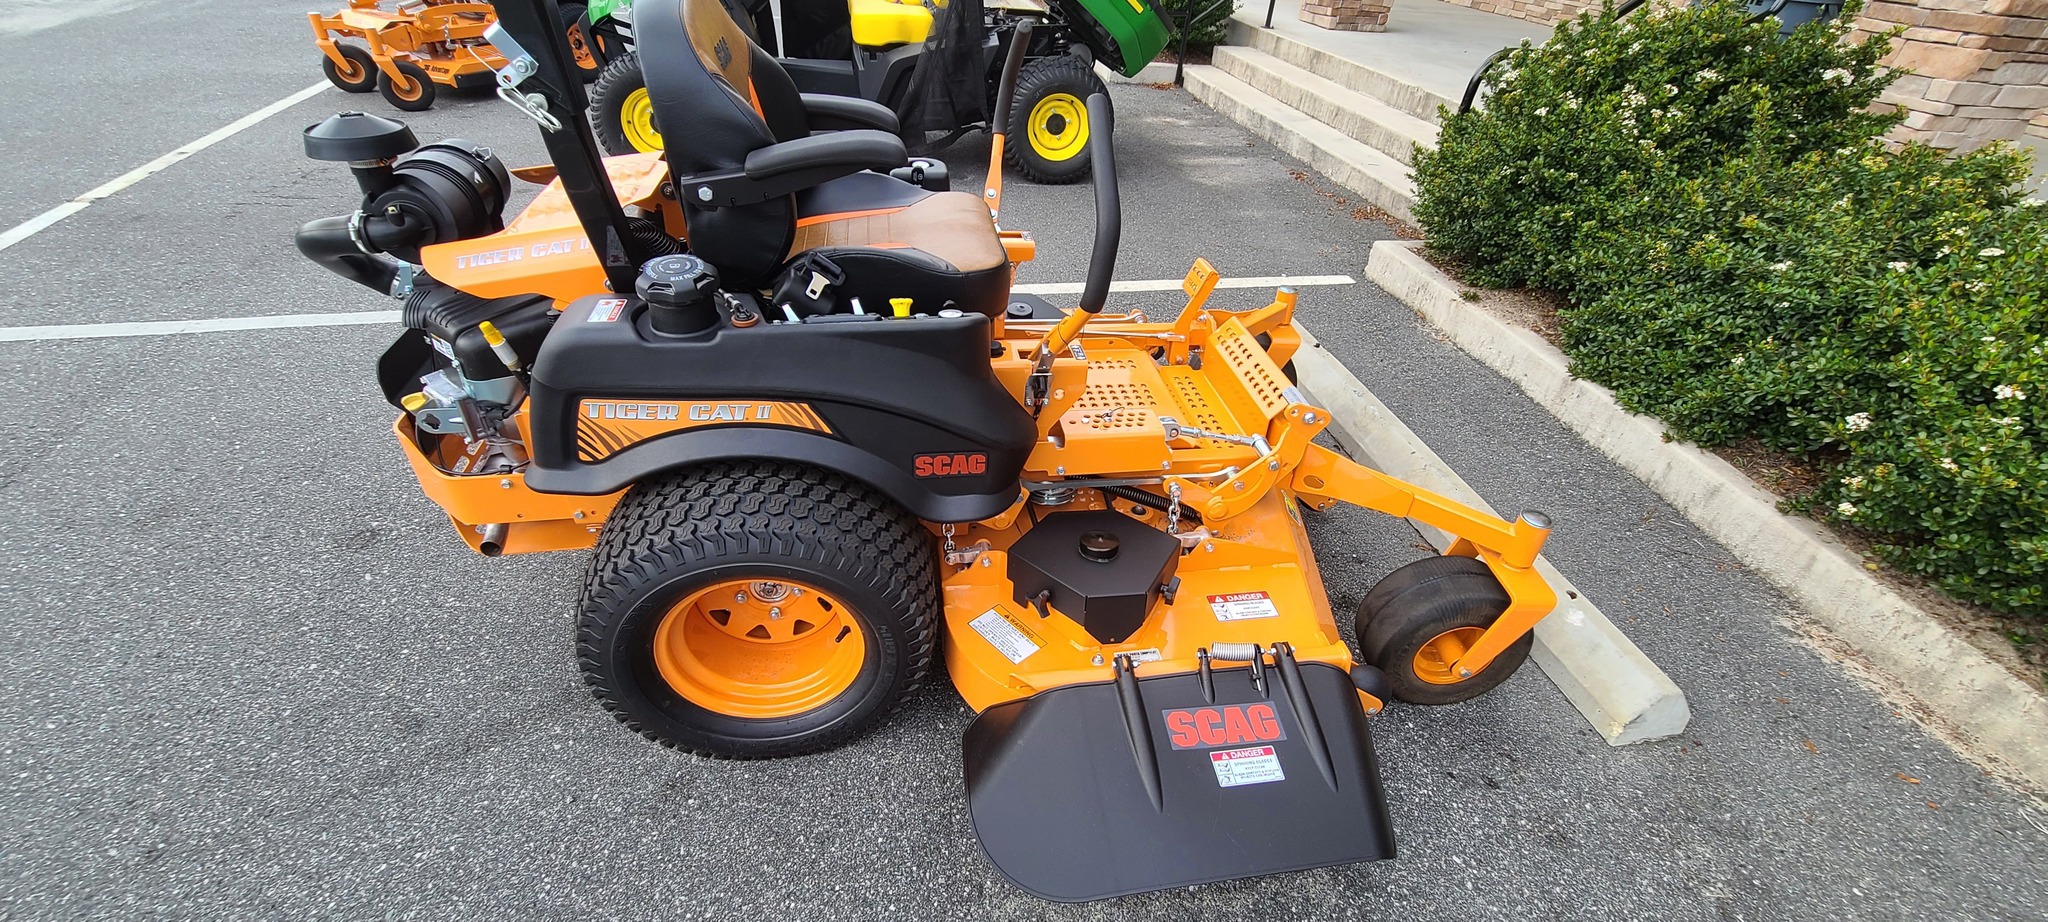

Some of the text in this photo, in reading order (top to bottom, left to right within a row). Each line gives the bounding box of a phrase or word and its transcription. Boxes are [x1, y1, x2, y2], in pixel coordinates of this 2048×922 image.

[432, 65, 450, 74] Advantage
[455, 247, 524, 269] TIGER
[531, 239, 576, 258] CAT
[583, 402, 773, 421] TIGER CAT II
[915, 454, 986, 477] SCAG
[1226, 593, 1264, 602] DANGER
[1010, 618, 1034, 639] WARNING
[1167, 704, 1281, 748] SCAG
[1230, 749, 1264, 759] DANGER
